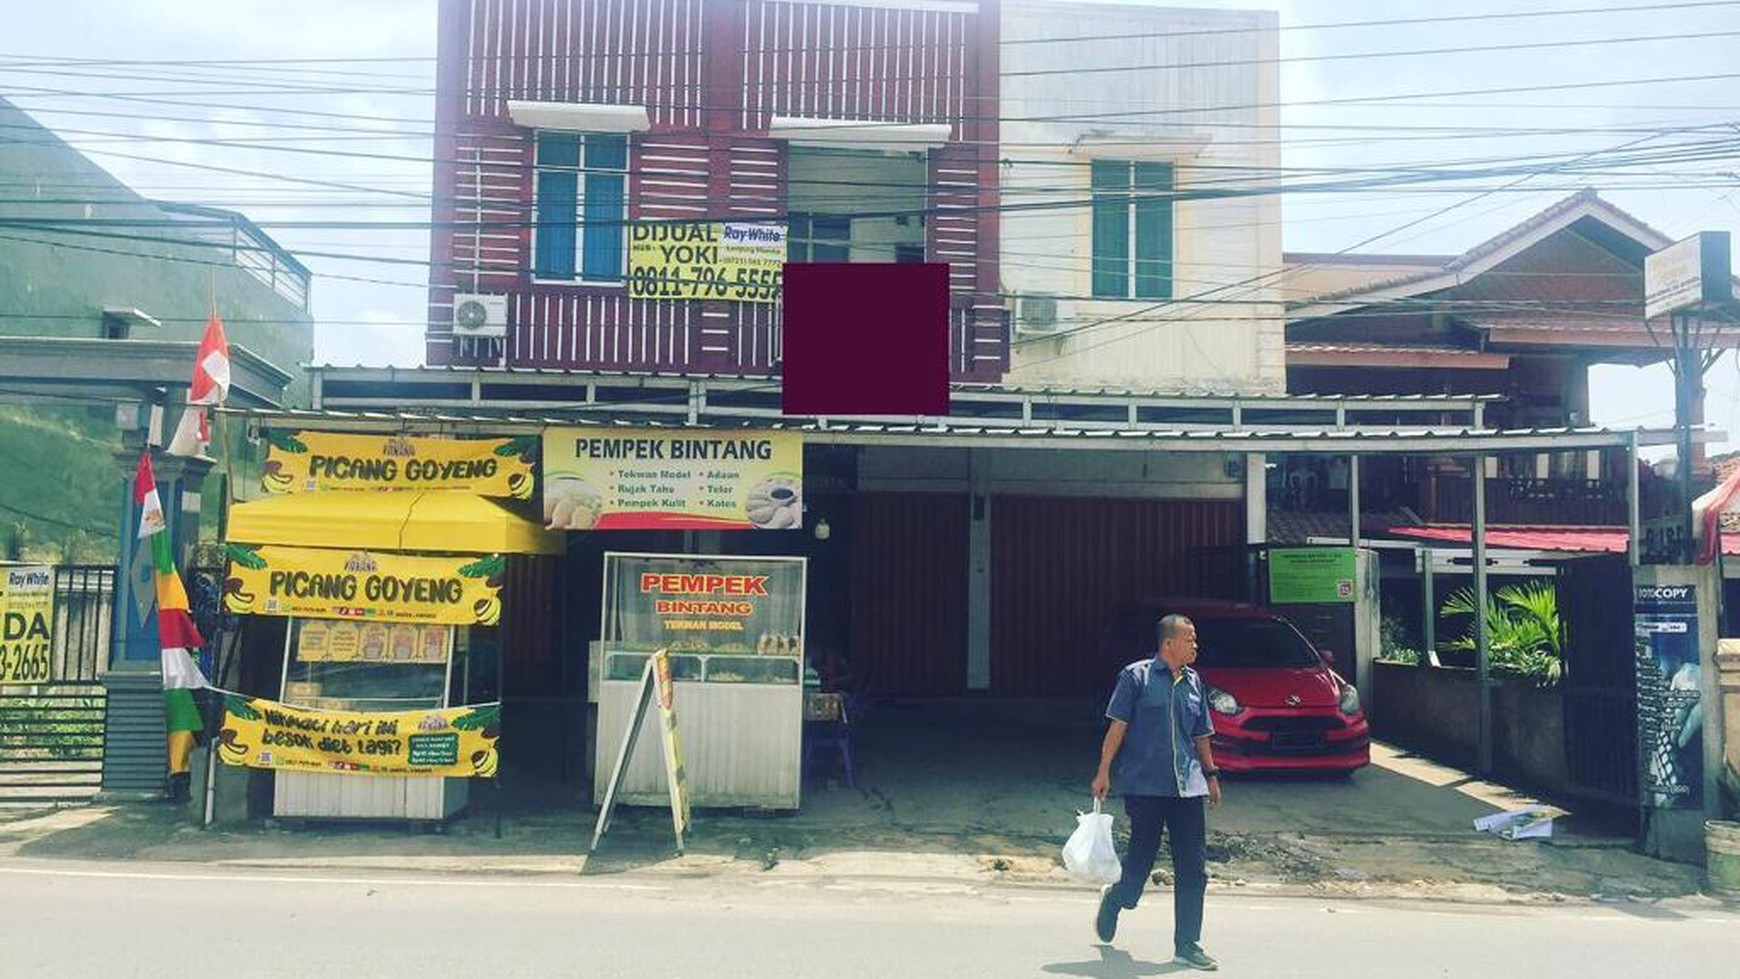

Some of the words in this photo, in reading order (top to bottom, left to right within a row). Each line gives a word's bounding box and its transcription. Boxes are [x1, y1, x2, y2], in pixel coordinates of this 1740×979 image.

[633, 224, 718, 242] DIJUAL
[724, 226, 748, 242] Ray
[748, 228, 780, 242] White
[660, 246, 718, 264] YOKI
[576, 438, 664, 459] PEMPEK
[671, 440, 772, 460] BINTANG
[310, 455, 397, 481] PICANG
[405, 458, 497, 480] GOYENG
[660, 470, 691, 478] Model
[618, 500, 658, 509] Pempek
[9, 571, 26, 588] Ray
[269, 571, 357, 600] PICANG
[365, 576, 463, 604] GOYENG
[641, 573, 769, 596] PEMPEK
[655, 600, 754, 615] BINTANG
[4, 612, 50, 640] DA
